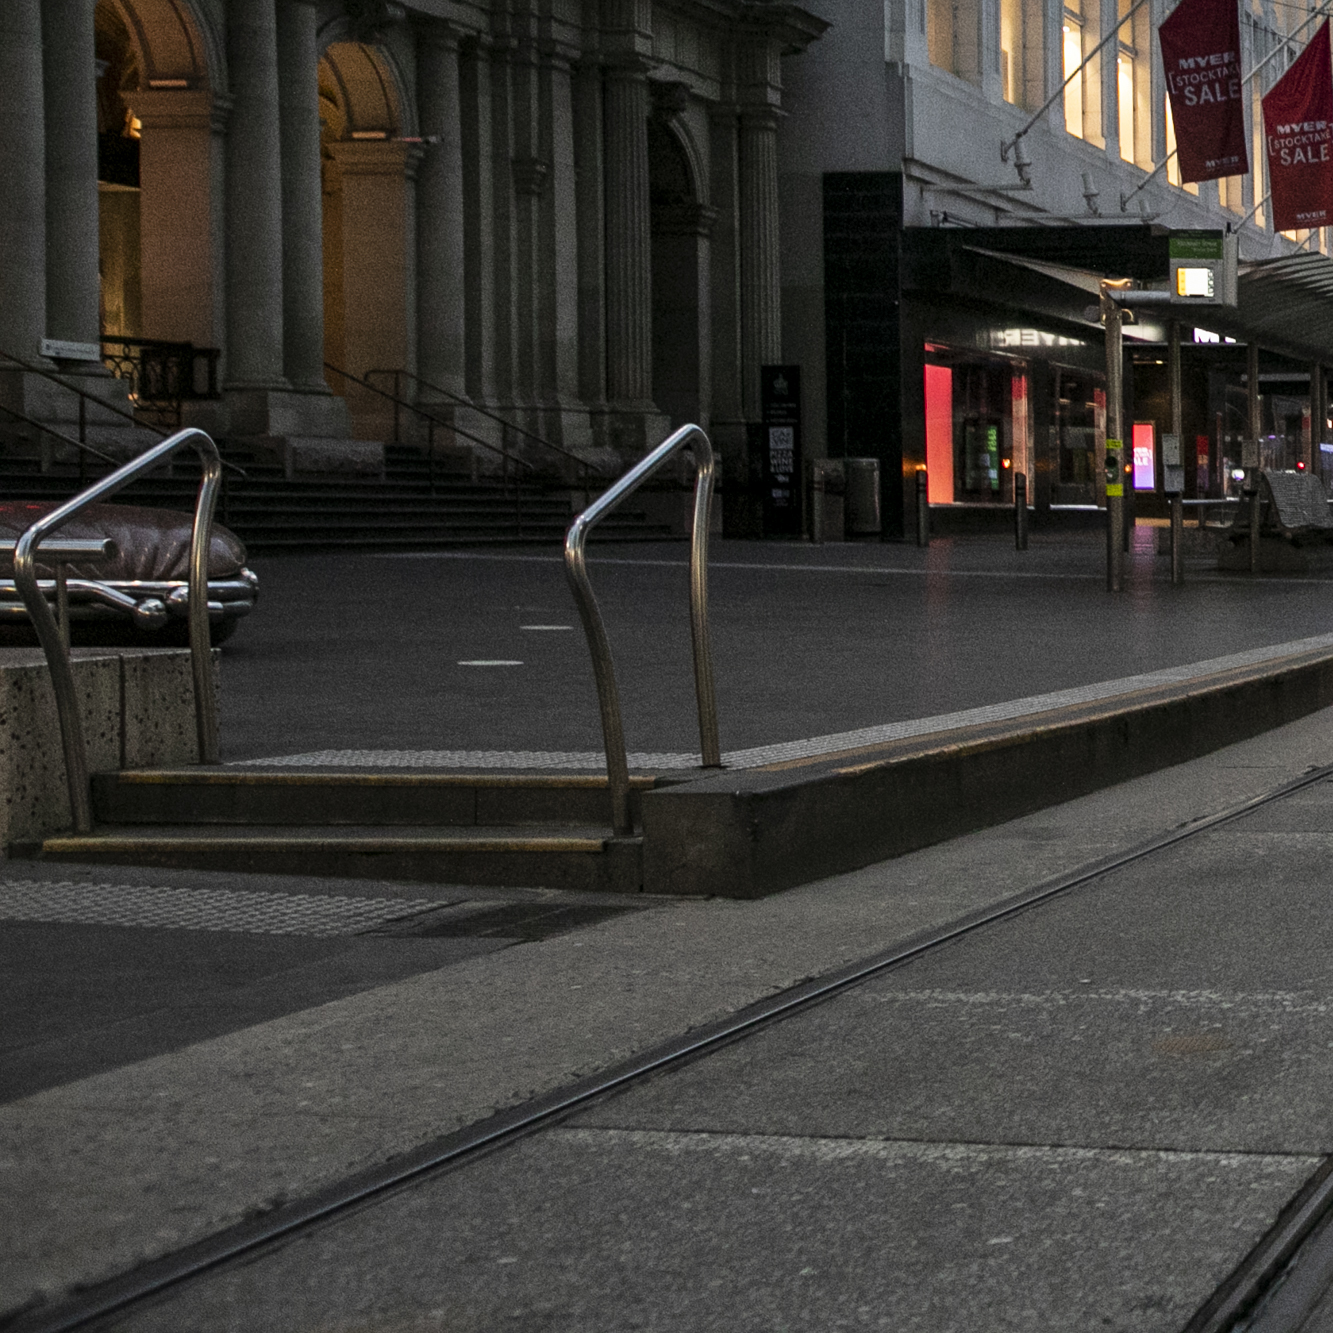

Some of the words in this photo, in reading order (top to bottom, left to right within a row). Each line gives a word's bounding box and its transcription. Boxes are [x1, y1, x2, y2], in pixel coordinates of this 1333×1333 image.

[1179, 51, 1236, 70] MYER
[1184, 78, 1241, 106] SALE
[1276, 120, 1328, 135] MYER
[1274, 130, 1332, 148] STOCKTAKE
[1205, 155, 1239, 168] MYER
[1280, 144, 1330, 166] SALE
